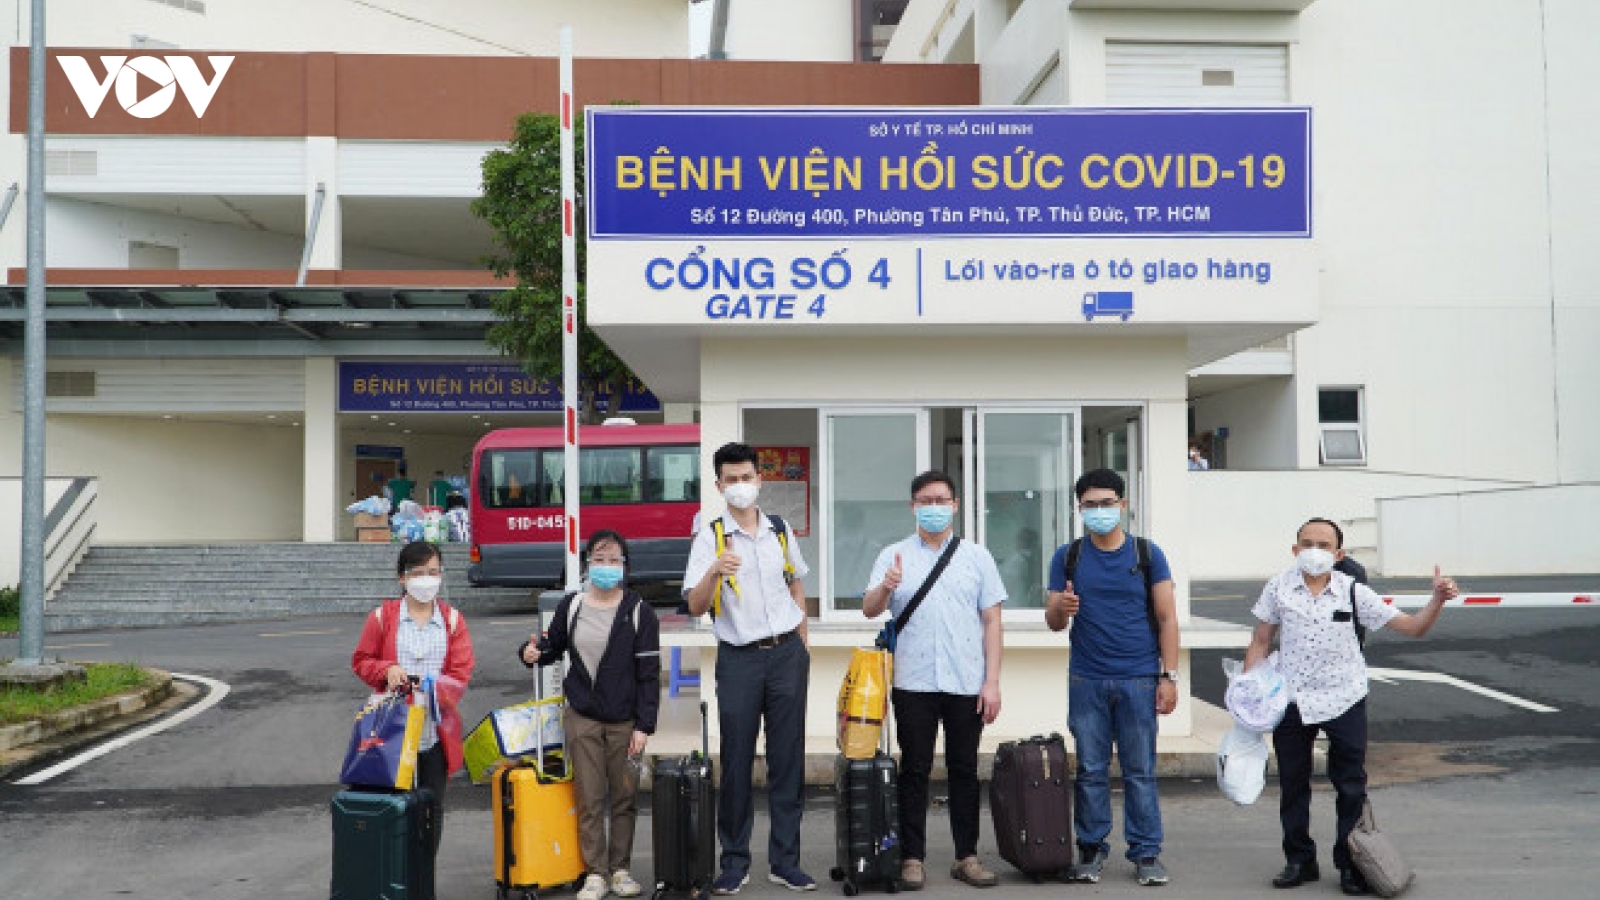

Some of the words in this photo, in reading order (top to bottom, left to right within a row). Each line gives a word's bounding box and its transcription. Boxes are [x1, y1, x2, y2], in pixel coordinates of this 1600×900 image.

[869, 122, 888, 137] SỞ
[891, 124, 901, 136] Y
[904, 121, 922, 136] TẾ
[947, 120, 968, 135] HỒ
[971, 121, 995, 135] CHÍ
[998, 123, 1034, 135] MINH
[616, 145, 743, 198] BỆNH
[758, 146, 863, 198] VIỆN
[879, 141, 956, 191] HỒI
[971, 145, 1065, 190] SỨC
[1080, 153, 1287, 189] COVID-19
[690, 206, 716, 225] Số
[720, 208, 742, 224] 12
[746, 206, 806, 227] Đường
[811, 208, 849, 227] 400,
[854, 206, 925, 226] Phường
[928, 205, 963, 223] Tân
[969, 206, 1010, 224] Phú,
[1016, 206, 1043, 222] TP.
[1048, 204, 1084, 222] Thủ
[1088, 205, 1129, 224] Đức,
[1134, 206, 1162, 222] TP.
[1167, 206, 1211, 222] HCM
[644, 245, 775, 290] CỔNG
[790, 247, 852, 290] SỐ
[867, 257, 892, 290] 4
[944, 258, 985, 281] Lối
[993, 260, 1075, 280] vào-ra
[1142, 258, 1199, 285] giao
[1206, 257, 1272, 285] hàng
[705, 293, 798, 319] GATE
[807, 293, 827, 319] 4
[353, 374, 410, 396] BỆNH
[416, 374, 463, 396] VIỆN
